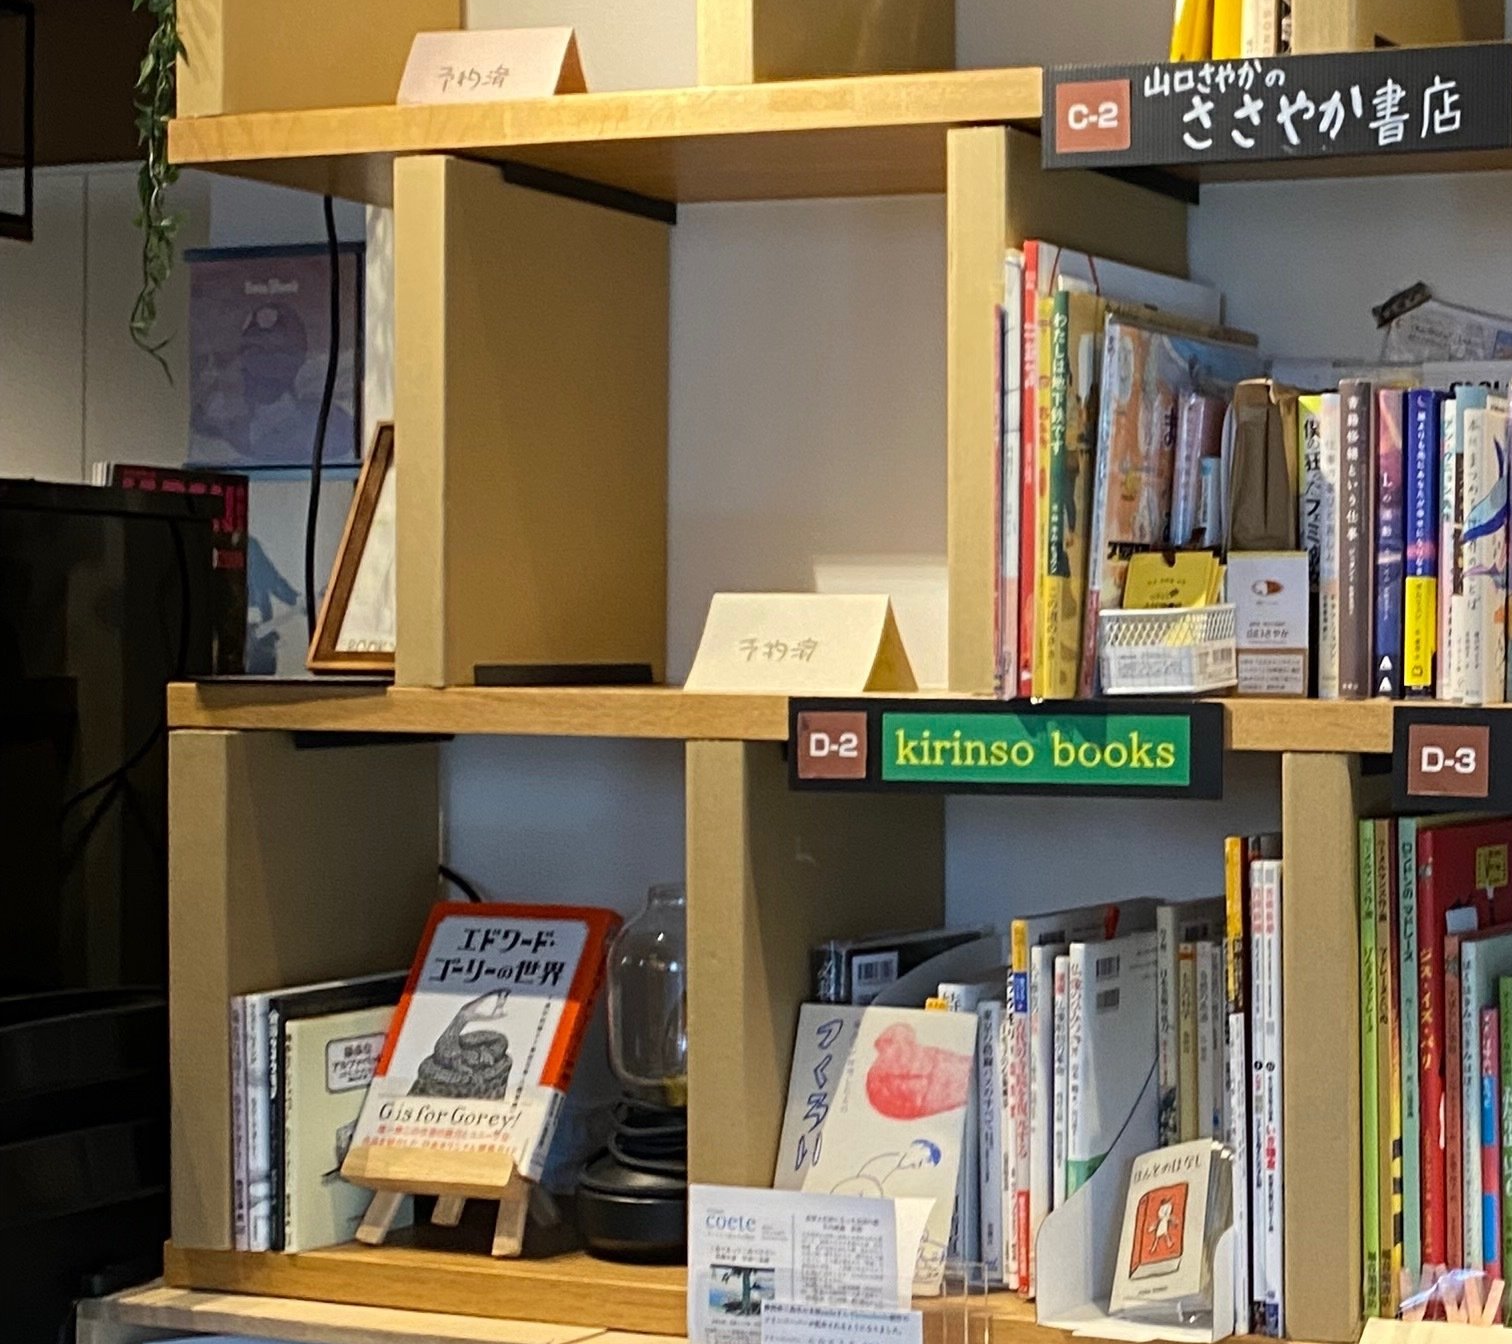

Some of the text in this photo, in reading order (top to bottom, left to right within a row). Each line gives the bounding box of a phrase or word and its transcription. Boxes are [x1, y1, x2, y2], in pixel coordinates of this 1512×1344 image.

[1144, 61, 1285, 97] 山口さやかの
[1068, 103, 1118, 130] C-2
[1183, 75, 1462, 150] ささやか書店
[809, 732, 858, 757] D-2
[896, 730, 1176, 768] kirinso books
[1421, 747, 1476, 774] D-3
[428, 958, 566, 987] ゴーリーの世界
[415, 1104, 449, 1123] for
